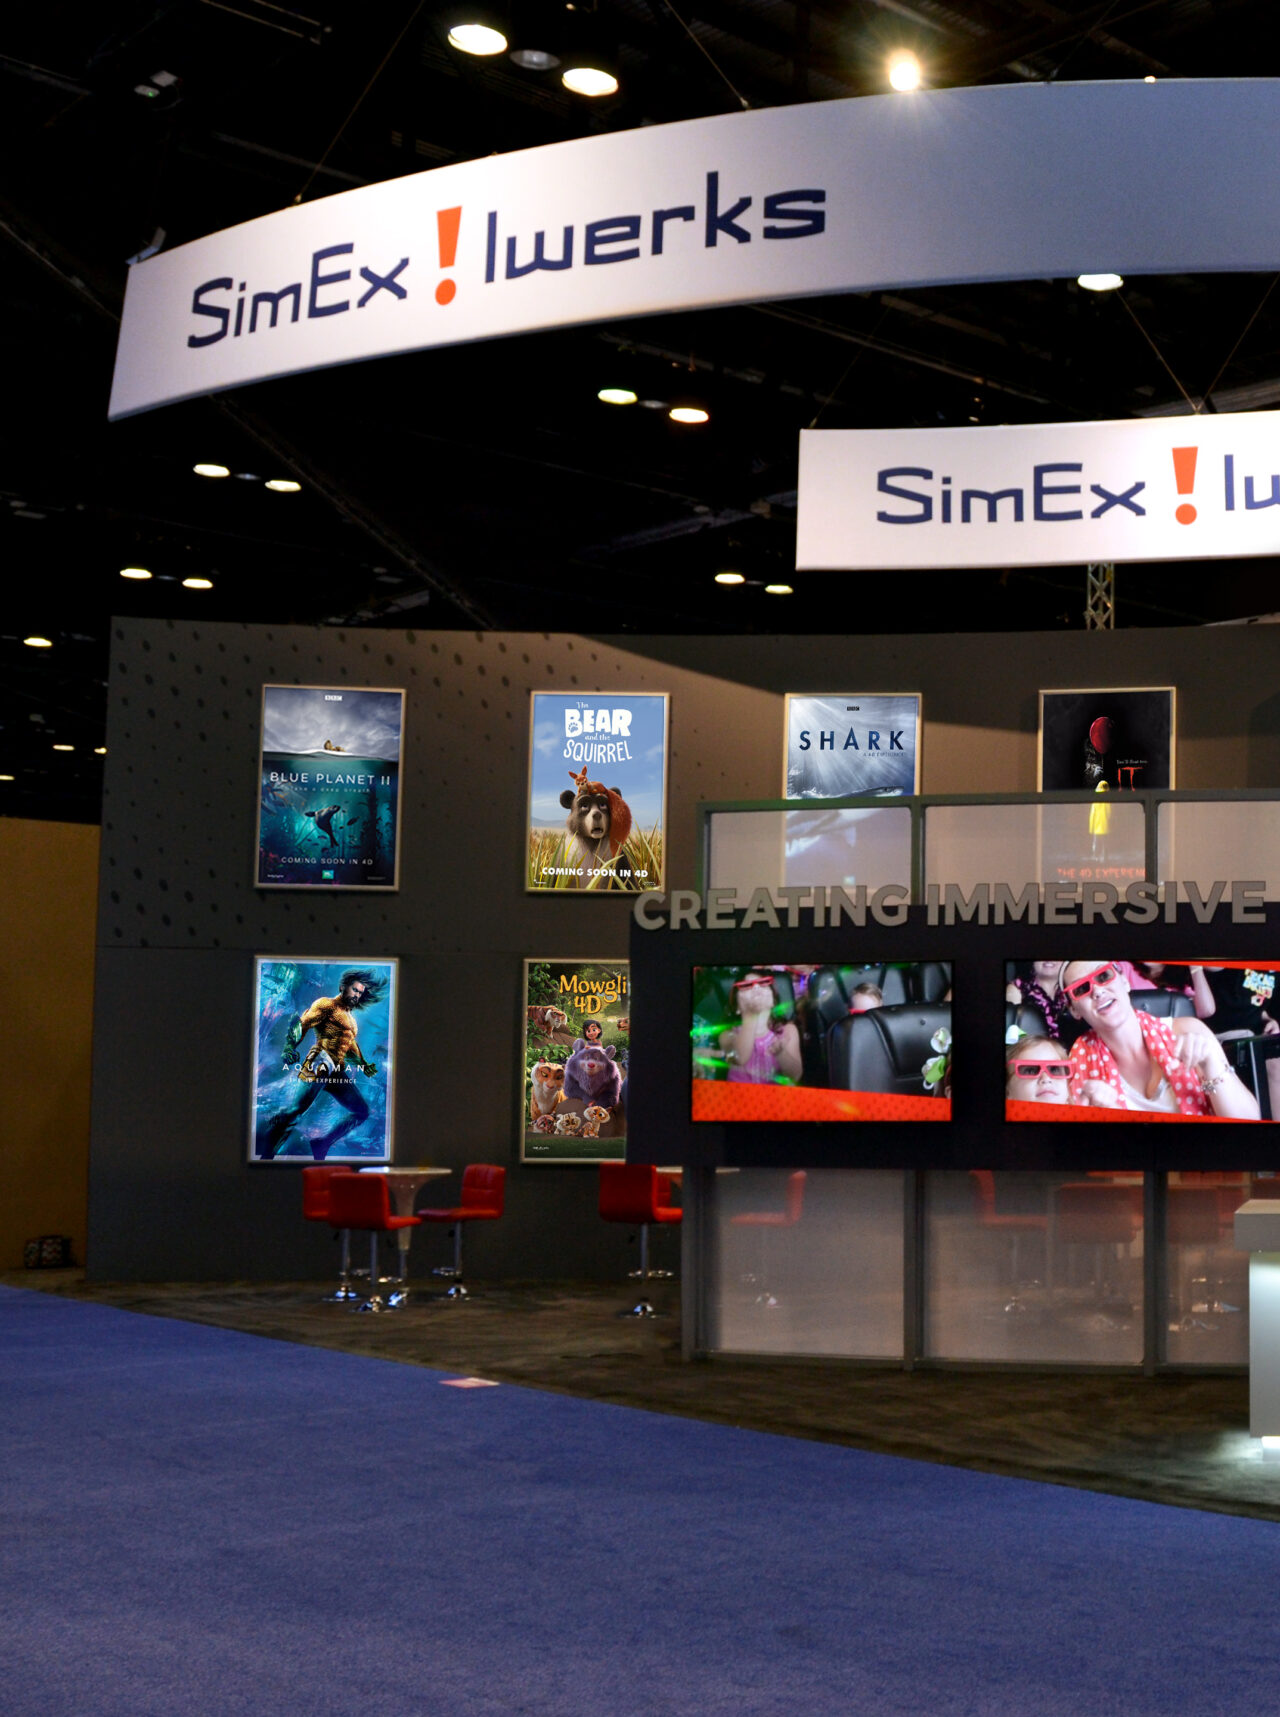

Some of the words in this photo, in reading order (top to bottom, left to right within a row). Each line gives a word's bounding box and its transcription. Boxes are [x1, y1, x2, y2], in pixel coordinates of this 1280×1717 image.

[187, 243, 409, 348] SimEx
[876, 462, 1146, 525] SimEx
[565, 709, 632, 738] BEAR
[799, 726, 904, 750] SHARK
[563, 739, 632, 764] SQUIRREL
[270, 772, 309, 783] BLUE
[316, 773, 375, 785] PLANET
[381, 775, 391, 785] II
[1118, 766, 1145, 792] IT
[281, 856, 317, 865] COMING
[321, 857, 345, 865] SOON
[542, 867, 584, 876] COMING
[587, 868, 616, 877] SOON
[620, 869, 631, 877] IN
[634, 869, 648, 878] 4D
[634, 884, 910, 931] CREATING
[927, 880, 1268, 927] IMMERSIVE
[559, 974, 627, 1003] Mowgli
[574, 995, 601, 1014] 4D
[282, 1063, 365, 1072] AQUAMAN
